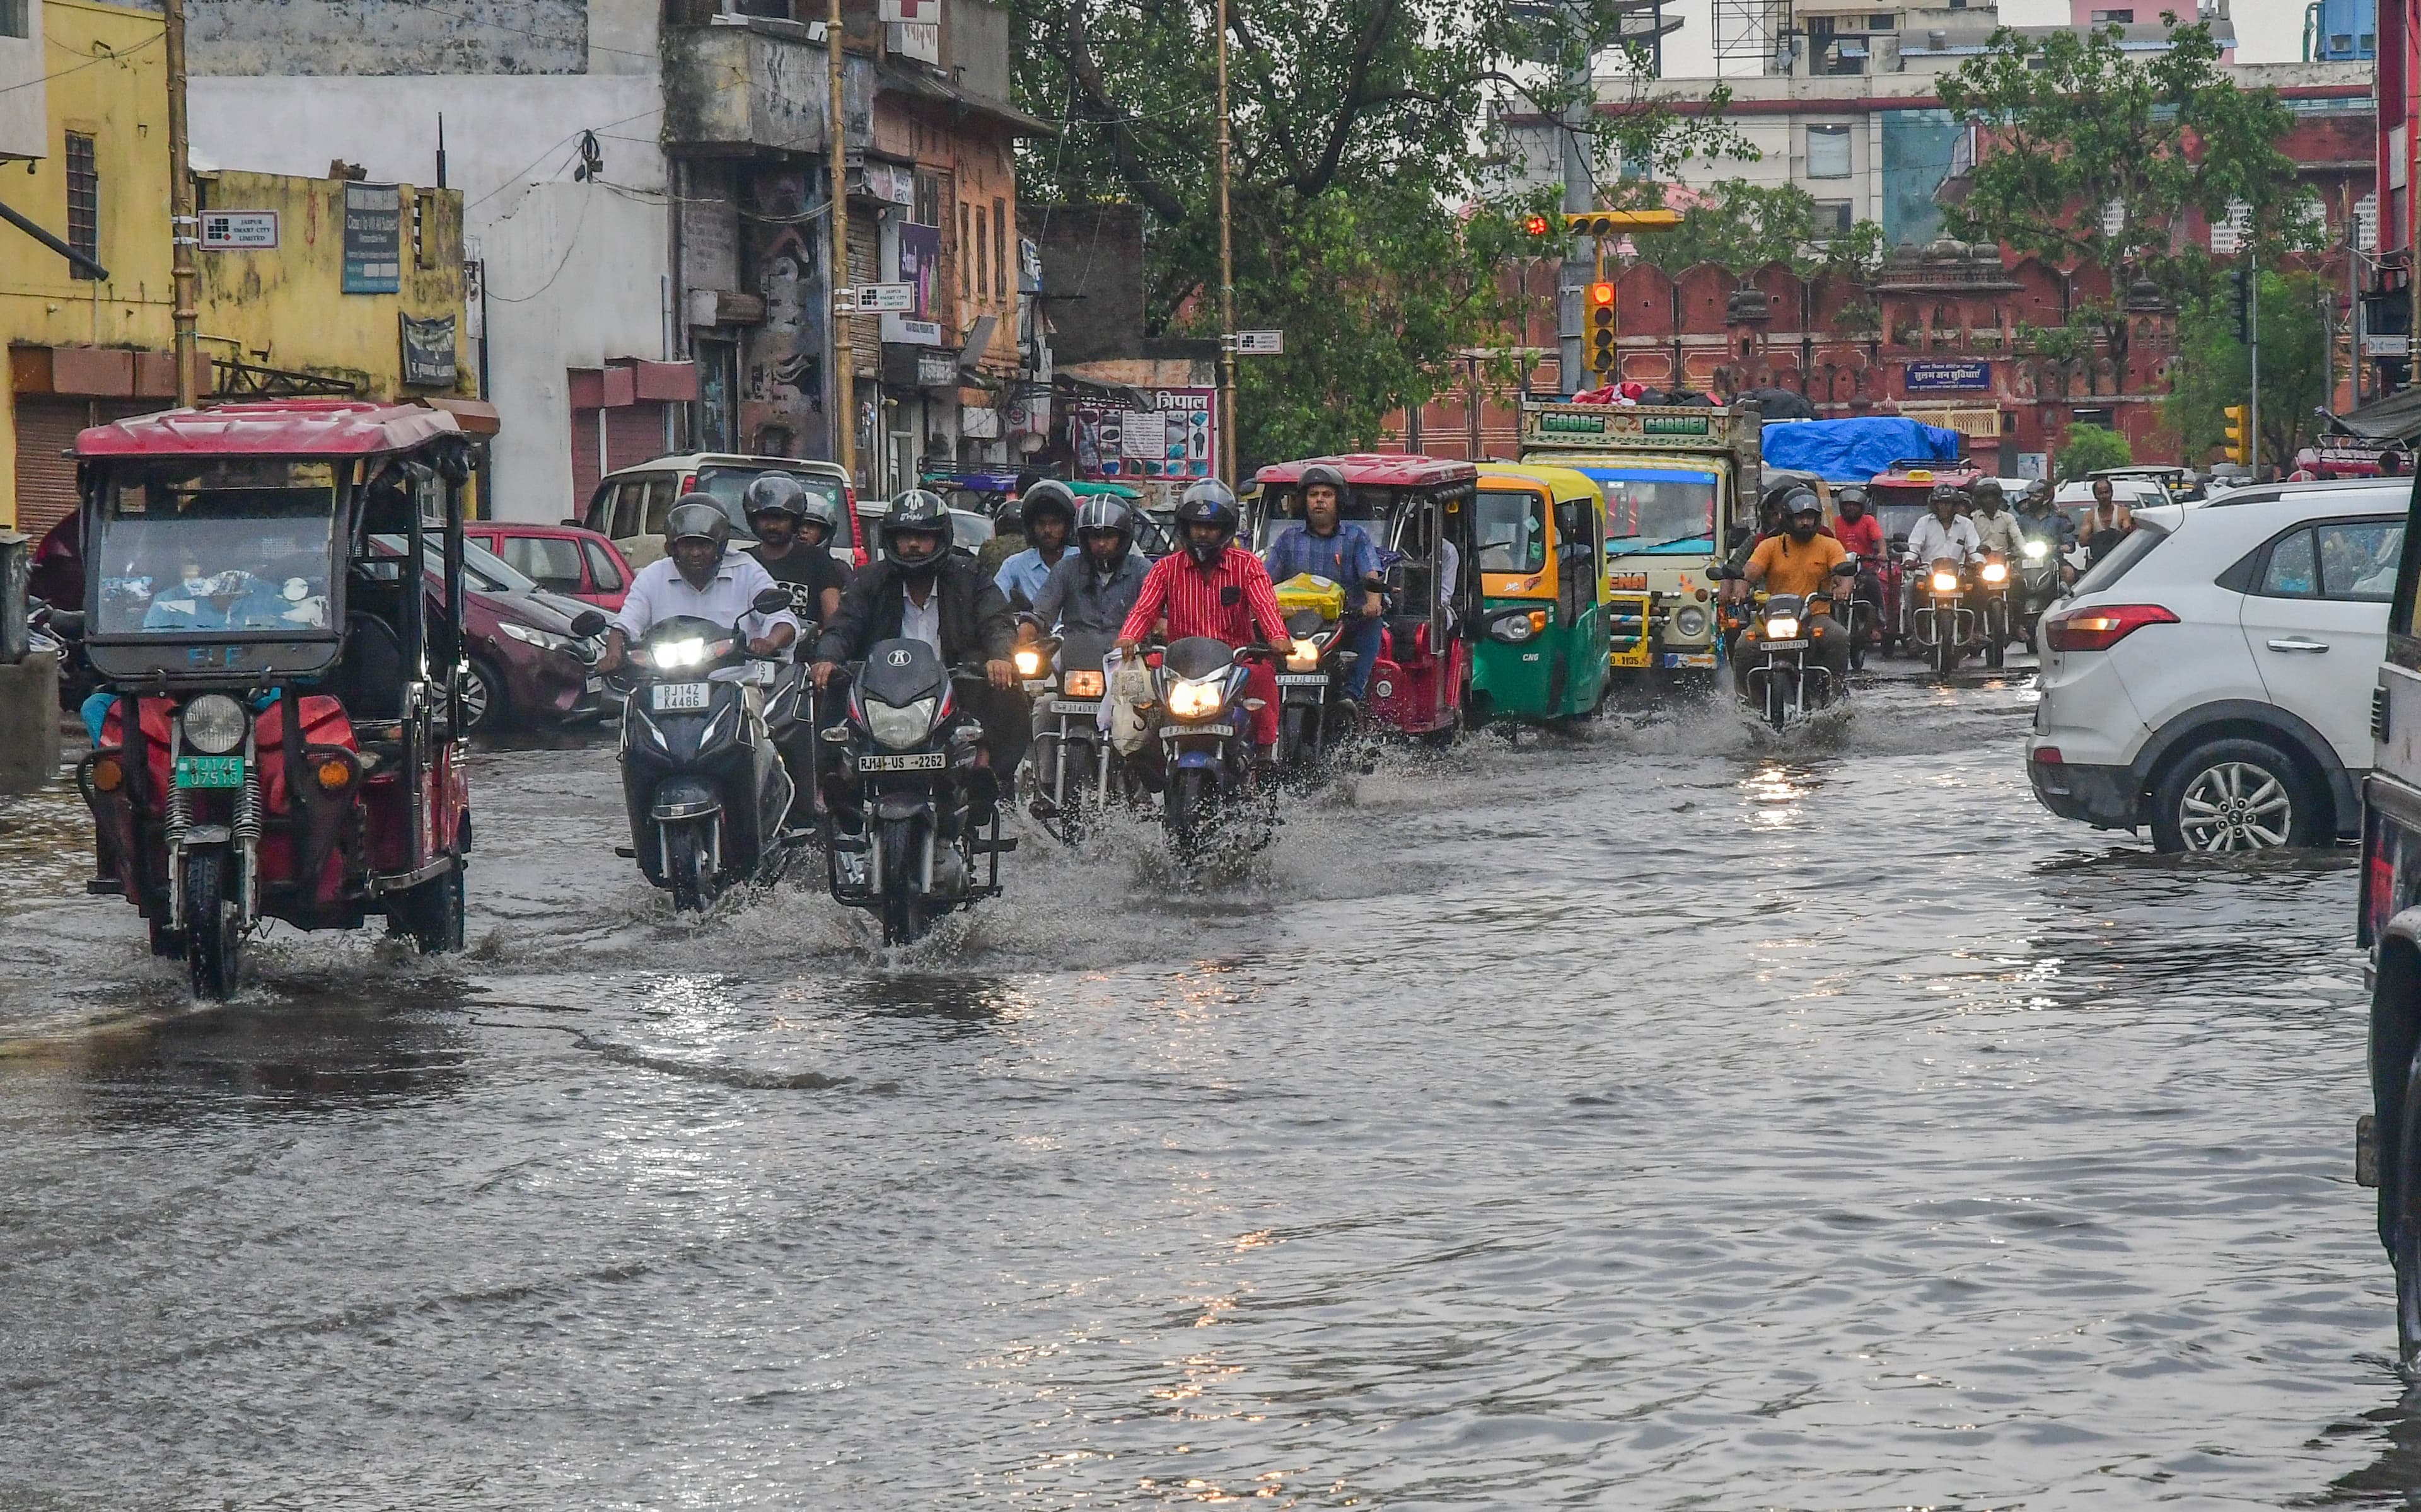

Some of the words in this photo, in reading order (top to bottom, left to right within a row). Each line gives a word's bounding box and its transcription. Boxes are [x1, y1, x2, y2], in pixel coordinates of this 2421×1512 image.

[1936, 371, 1949, 379] जन
[1156, 391, 1209, 410] त्रिपाल
[1542, 413, 1604, 432] GOODS
[1645, 417, 1708, 434] CARRIER
[1522, 653, 1539, 661] CNG
[665, 684, 699, 696] RJ14Z
[665, 696, 699, 708] K4486
